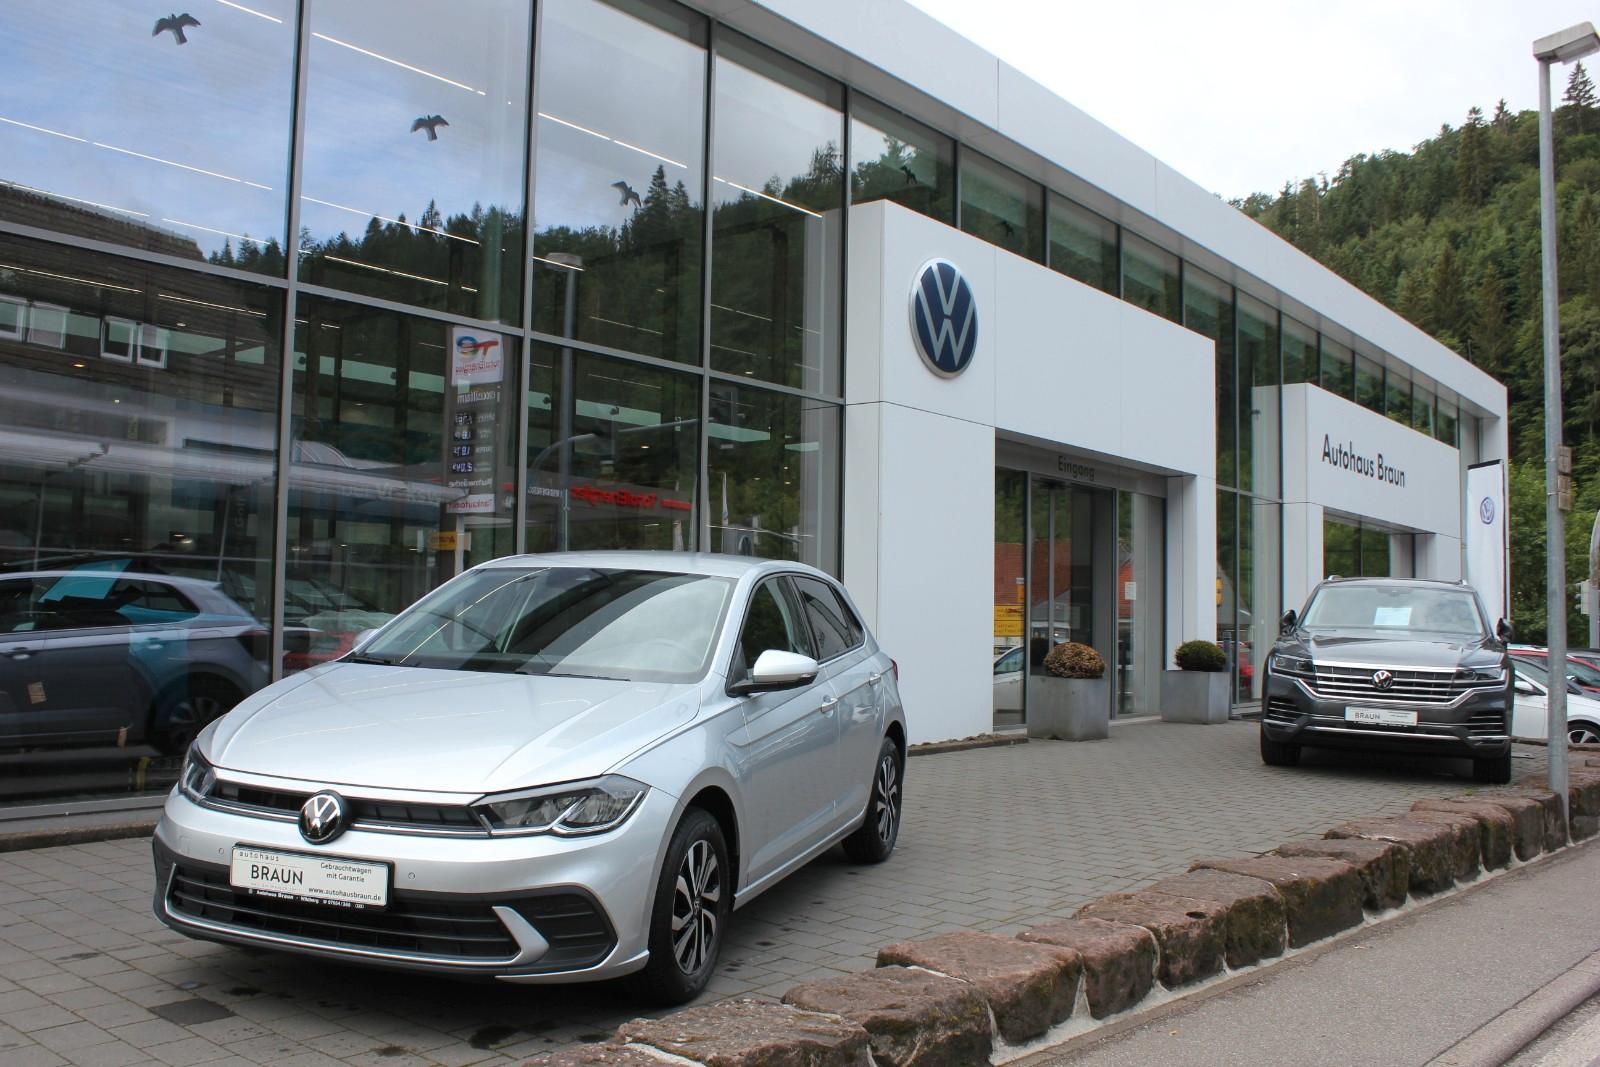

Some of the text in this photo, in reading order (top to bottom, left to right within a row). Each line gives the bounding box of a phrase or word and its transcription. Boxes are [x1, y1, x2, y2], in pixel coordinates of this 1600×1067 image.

[1322, 433, 1405, 488] Autohaus Braun
[1058, 455, 1096, 481] Eingang
[1354, 712, 1380, 720] BRAUN
[239, 851, 280, 862] autohaus
[251, 864, 303, 885] BRAUN
[320, 862, 372, 875] Gebrauchtwagen
[326, 872, 365, 883] mit Garantie
[308, 886, 382, 901] www.autohausbraun.de
